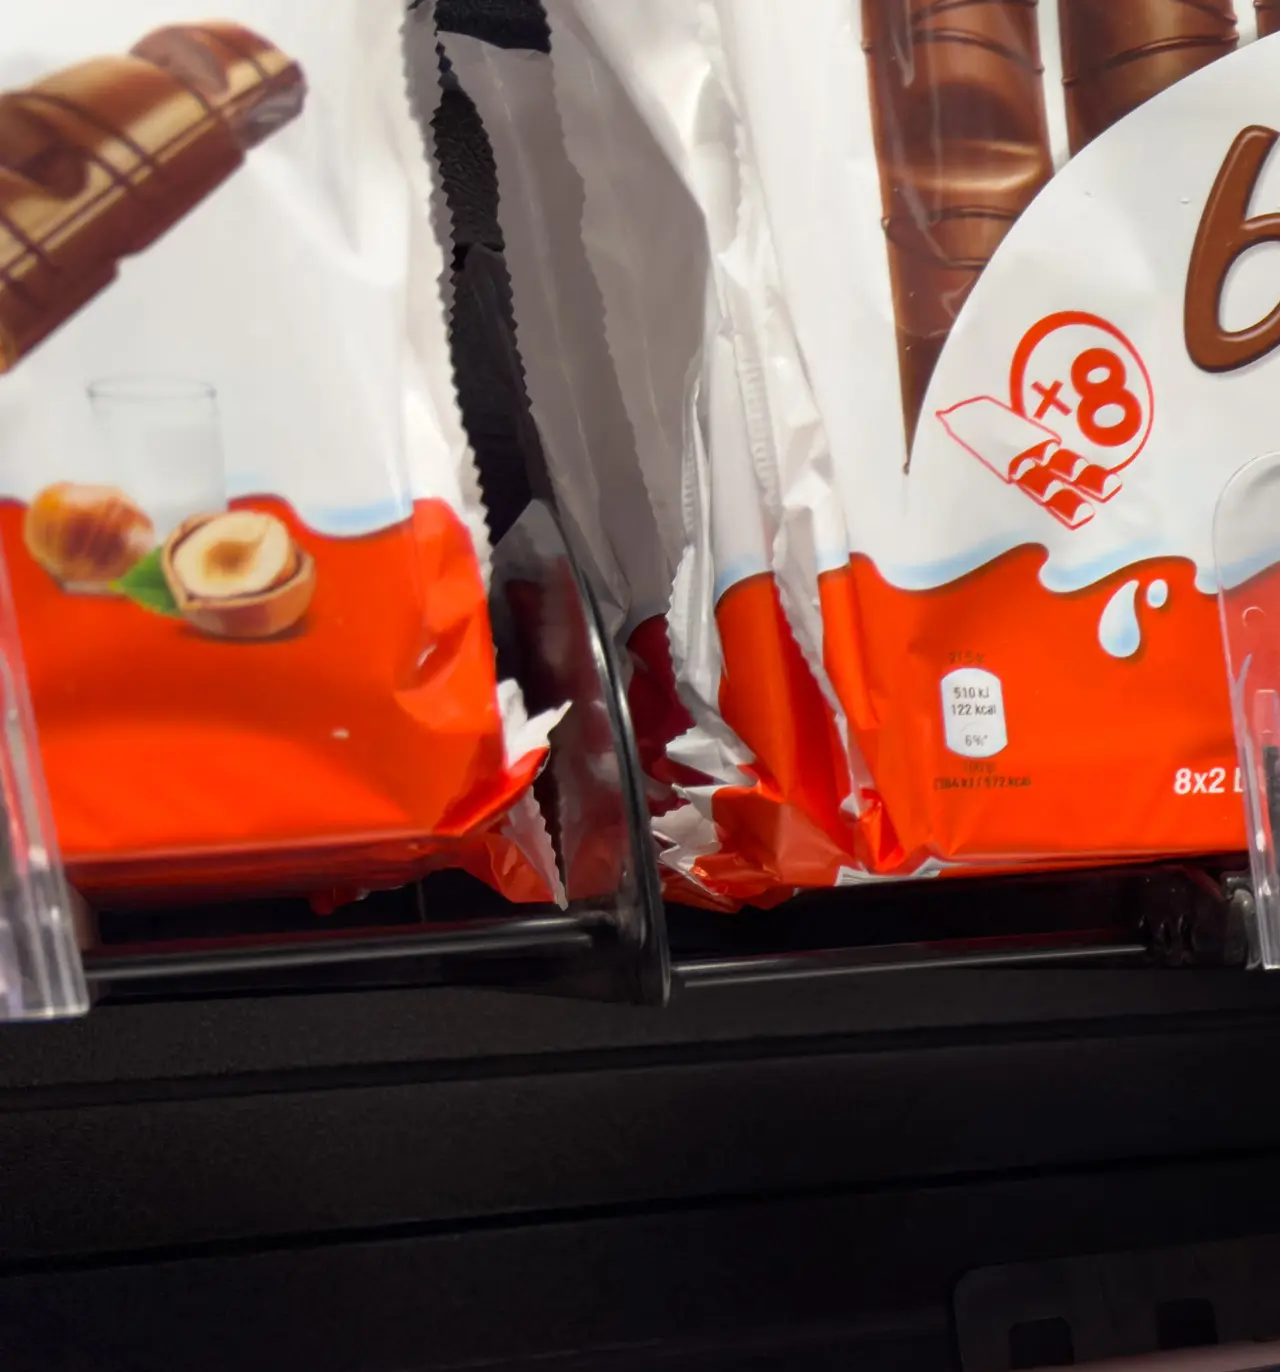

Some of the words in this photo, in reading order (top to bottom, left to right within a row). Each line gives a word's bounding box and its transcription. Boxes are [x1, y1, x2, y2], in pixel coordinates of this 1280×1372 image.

[953, 686, 975, 699] 510
[951, 703, 972, 716] 122
[974, 703, 997, 716] kcal
[1173, 767, 1226, 795] 8x2
